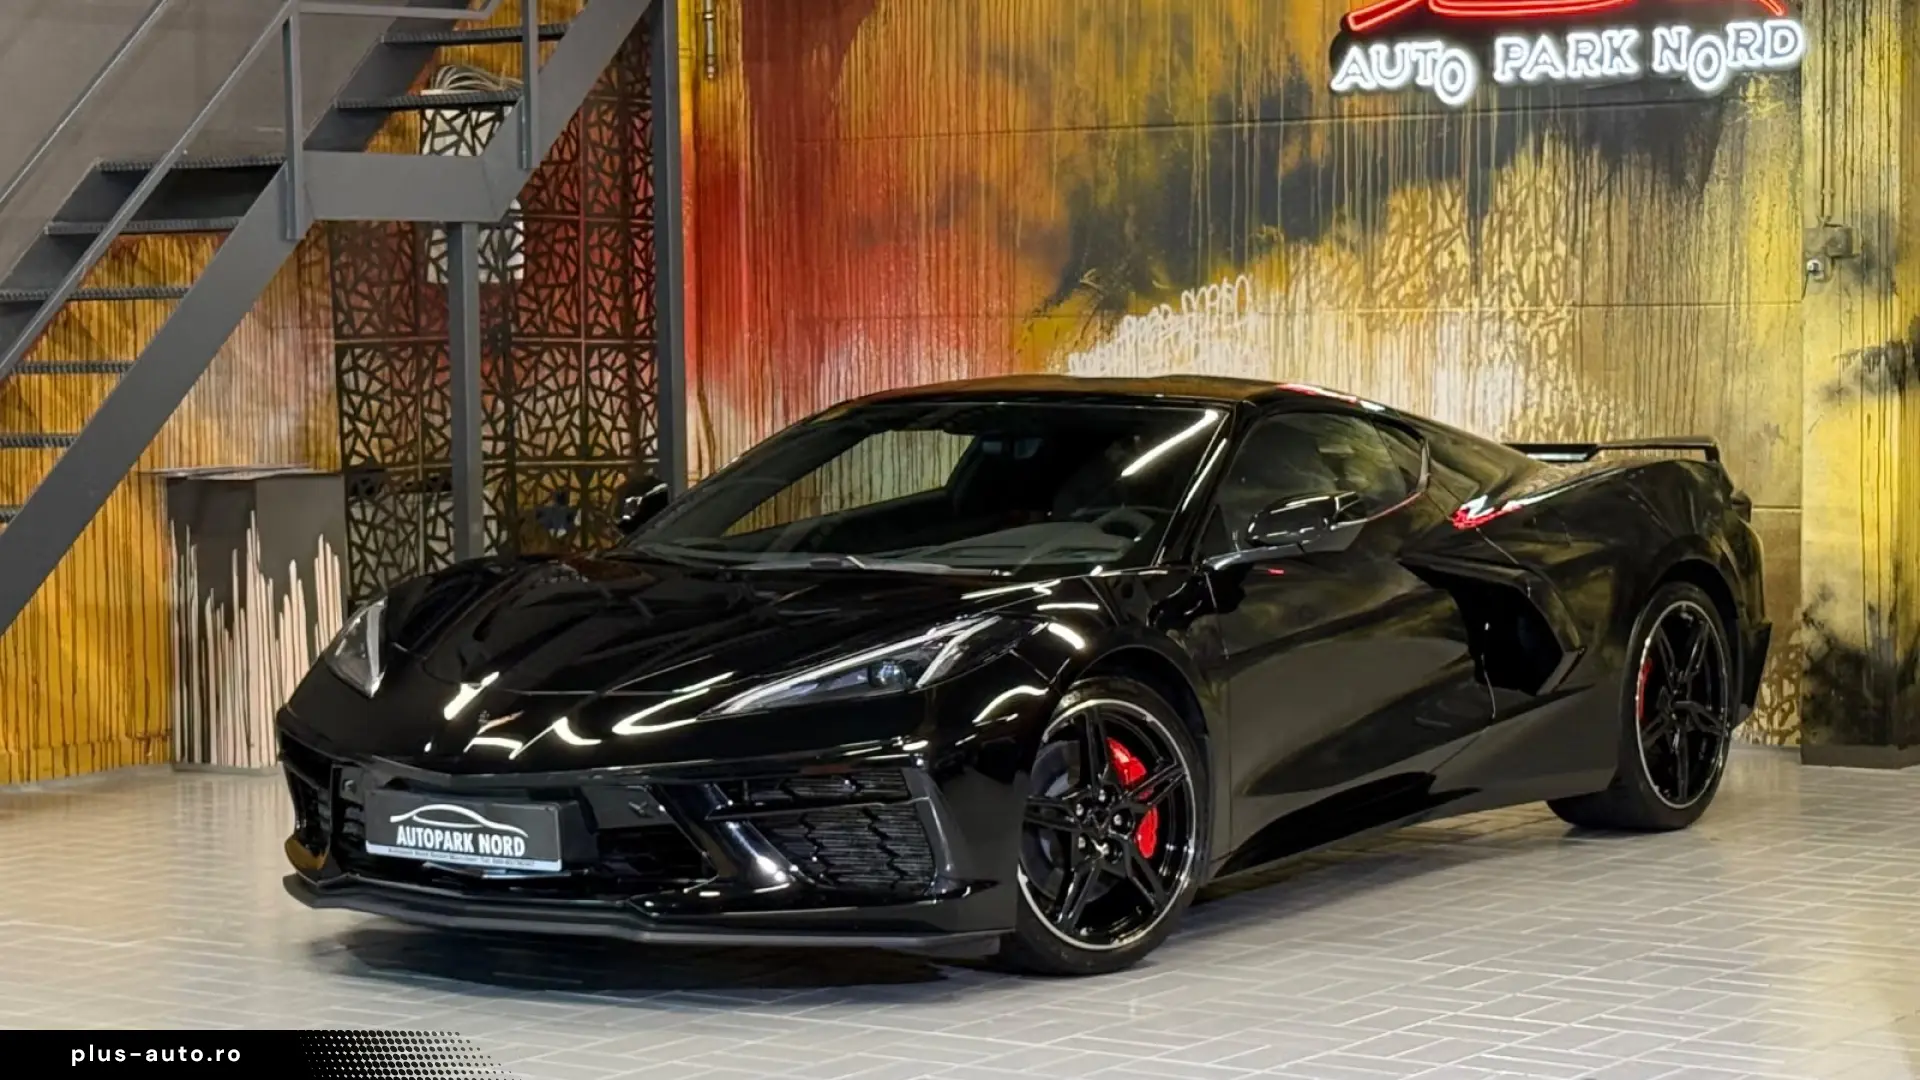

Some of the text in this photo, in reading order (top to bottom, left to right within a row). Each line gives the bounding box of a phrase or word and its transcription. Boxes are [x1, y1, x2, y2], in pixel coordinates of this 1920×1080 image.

[1331, 18, 1806, 105] AUTO PARK NORD
[396, 825, 475, 854] AUTOPARK
[478, 833, 526, 858] NORD
